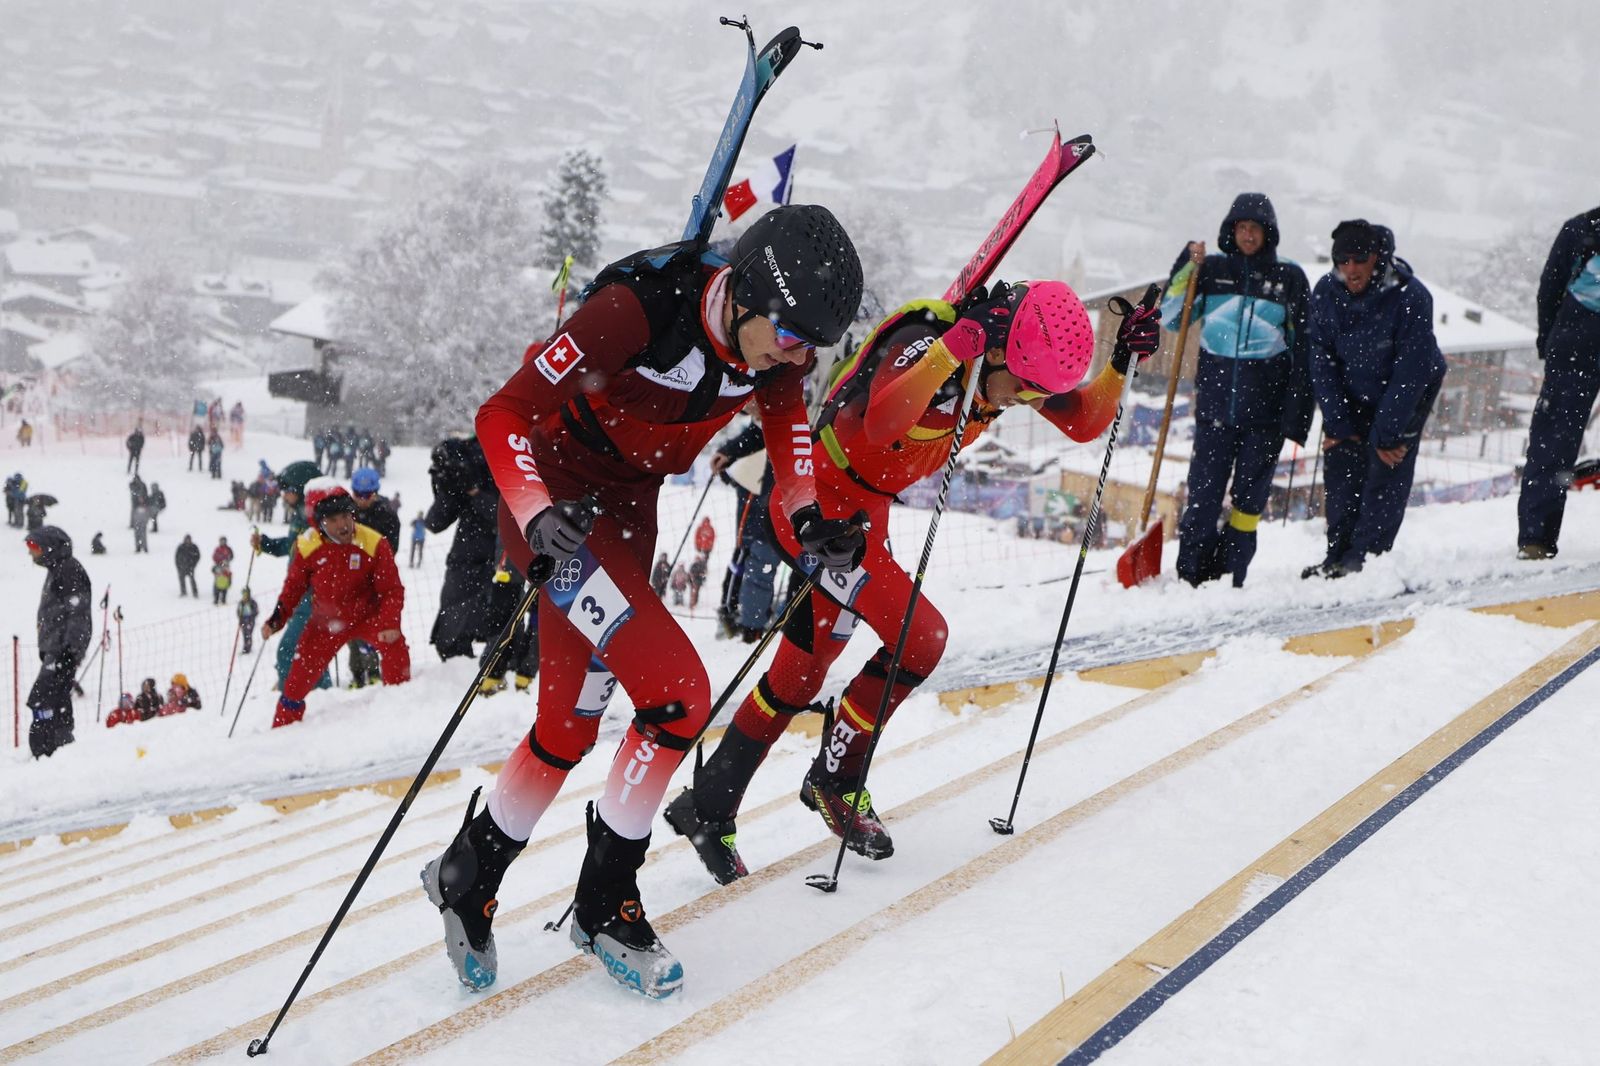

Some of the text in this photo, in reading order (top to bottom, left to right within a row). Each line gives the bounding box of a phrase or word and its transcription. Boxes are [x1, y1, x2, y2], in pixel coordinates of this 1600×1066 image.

[764, 245, 797, 307] SKITRAB
[1033, 303, 1052, 349] DYNAFIT
[544, 368, 557, 381] team
[508, 433, 543, 482] SUI
[792, 424, 814, 476] SUI
[935, 409, 968, 517] DYNAFIT
[1096, 402, 1124, 501] DYNAFIT
[828, 569, 848, 590] 6
[581, 595, 606, 626] 3
[600, 676, 618, 702] 3
[825, 719, 858, 773] ESP
[619, 740, 660, 805] SUI
